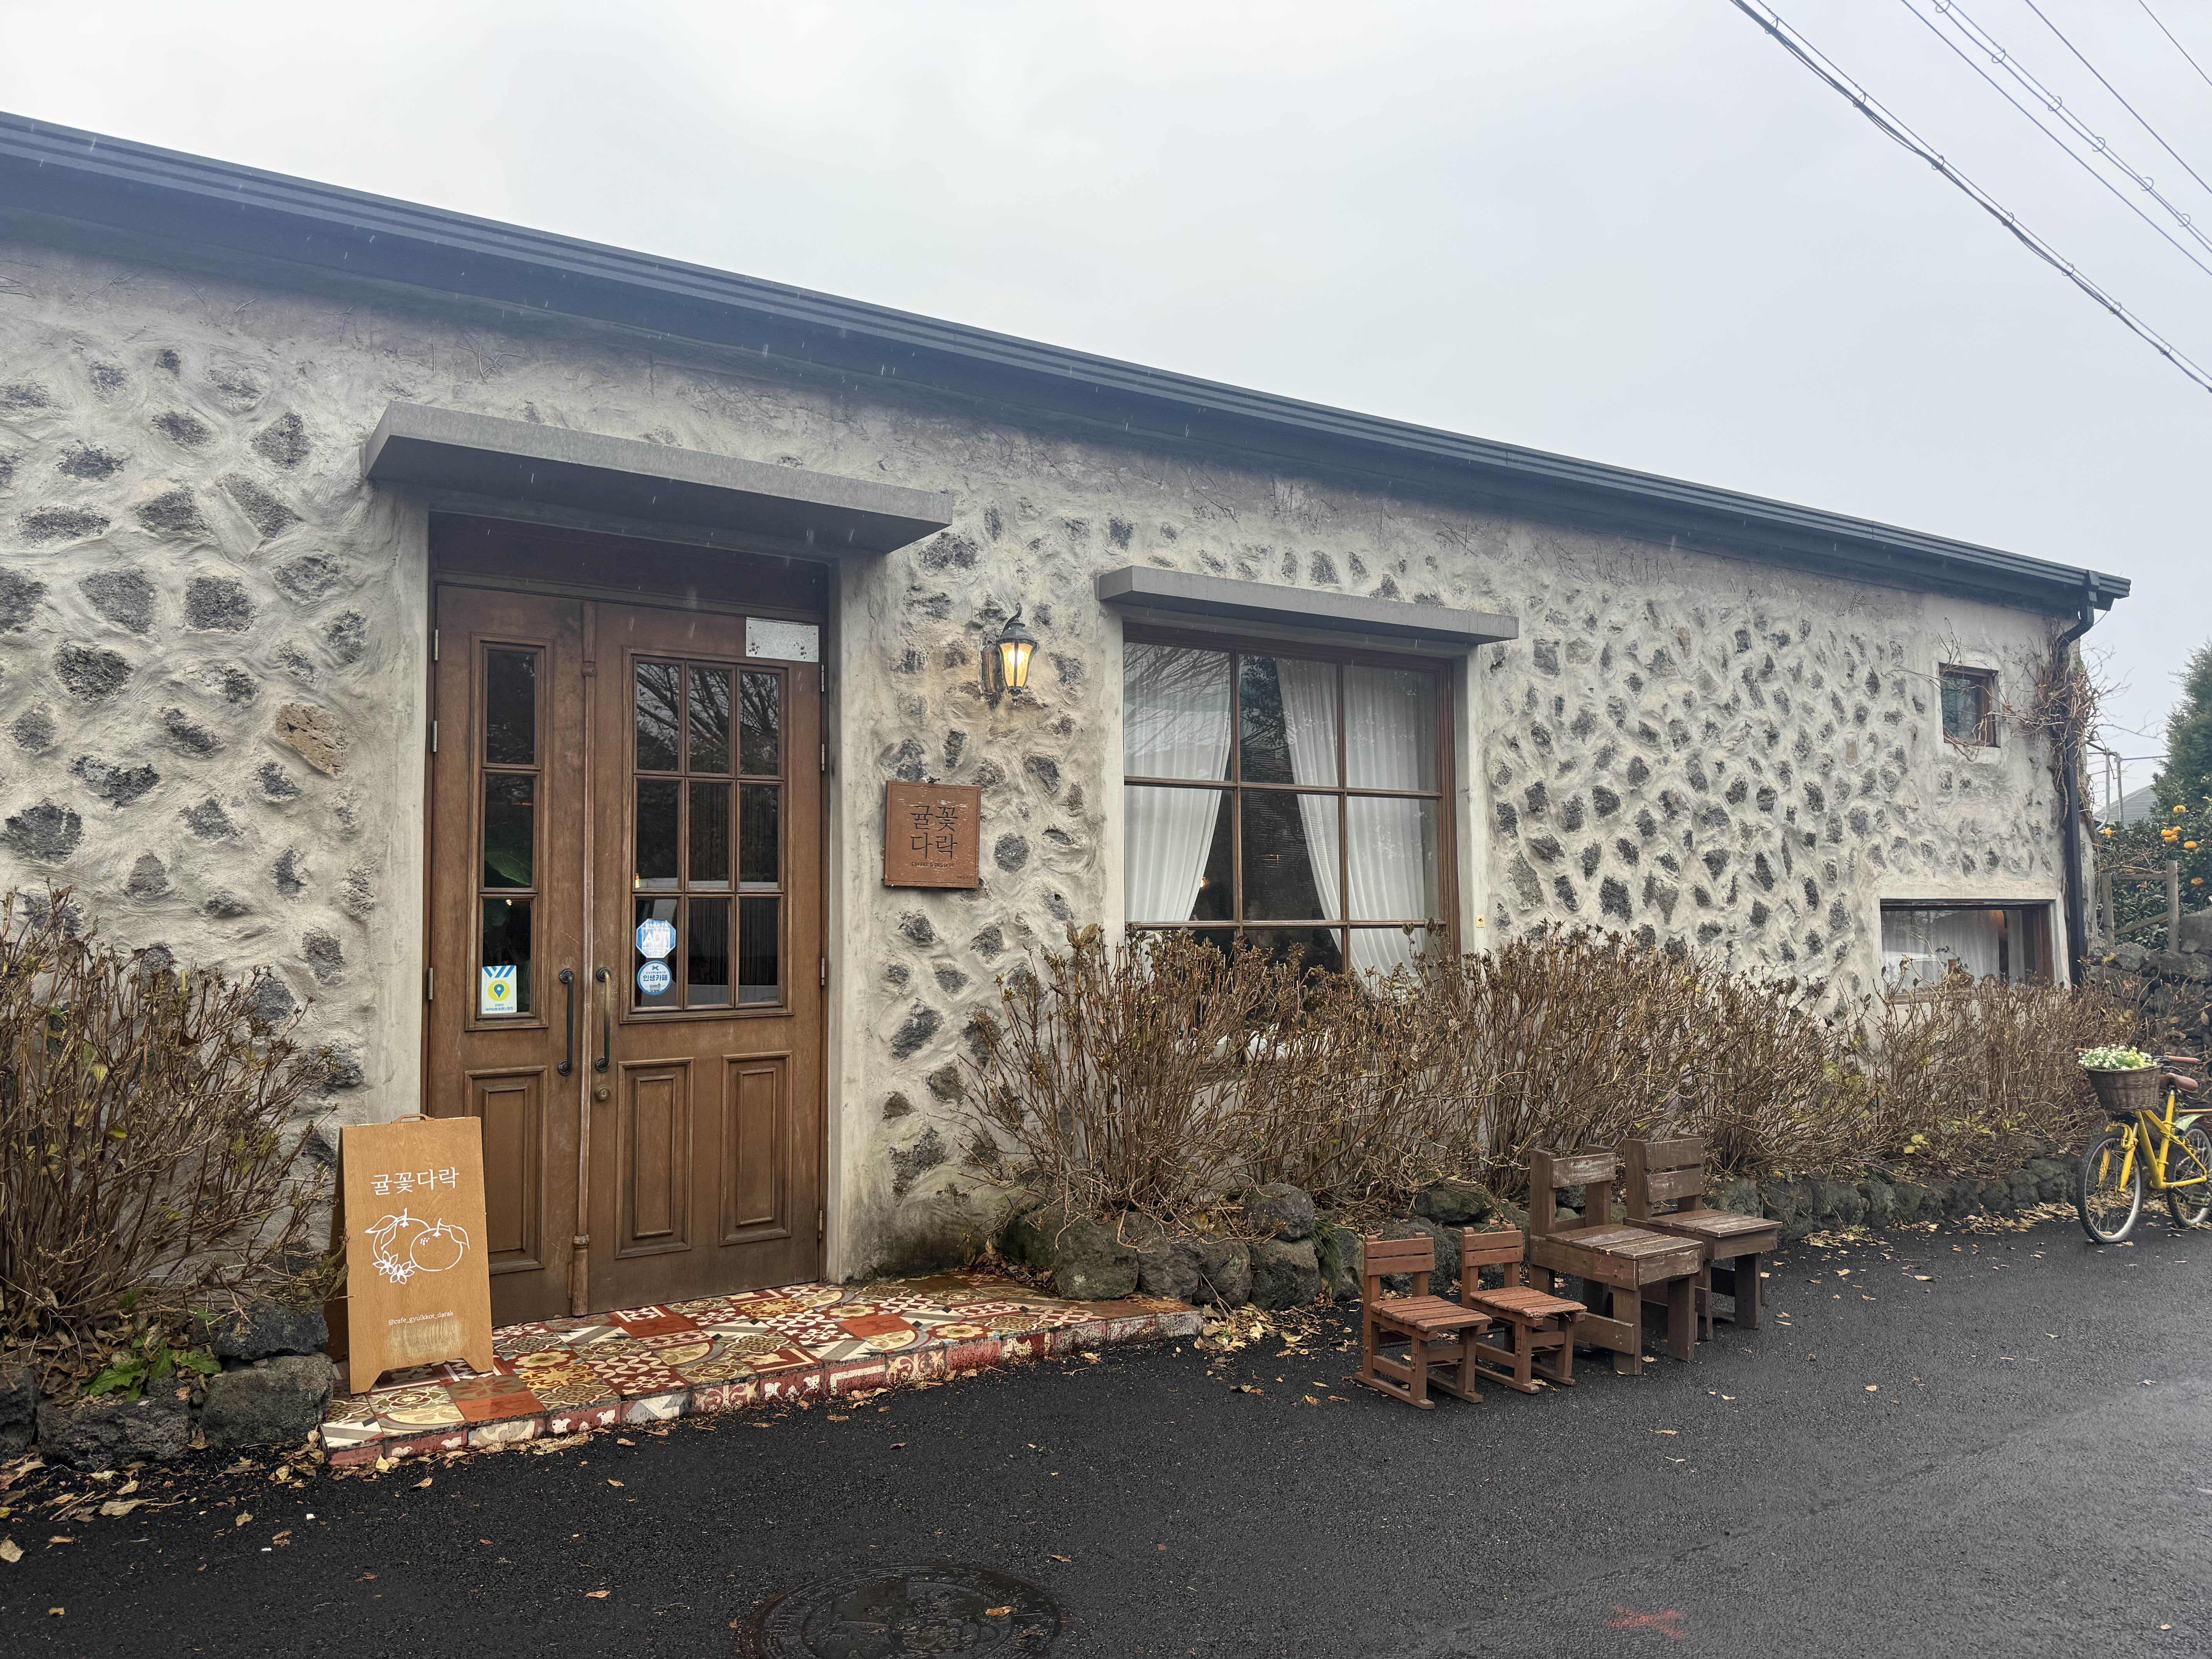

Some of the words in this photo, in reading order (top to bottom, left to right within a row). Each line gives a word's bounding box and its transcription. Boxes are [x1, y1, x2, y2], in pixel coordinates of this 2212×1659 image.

[910, 805, 958, 831] 귤꽃
[910, 832, 958, 860] 다락
[643, 931, 670, 947] ADT
[370, 1166, 460, 1195] 귤꽃다락
[388, 1310, 454, 1325] @cafe_gyulkkot_darak
